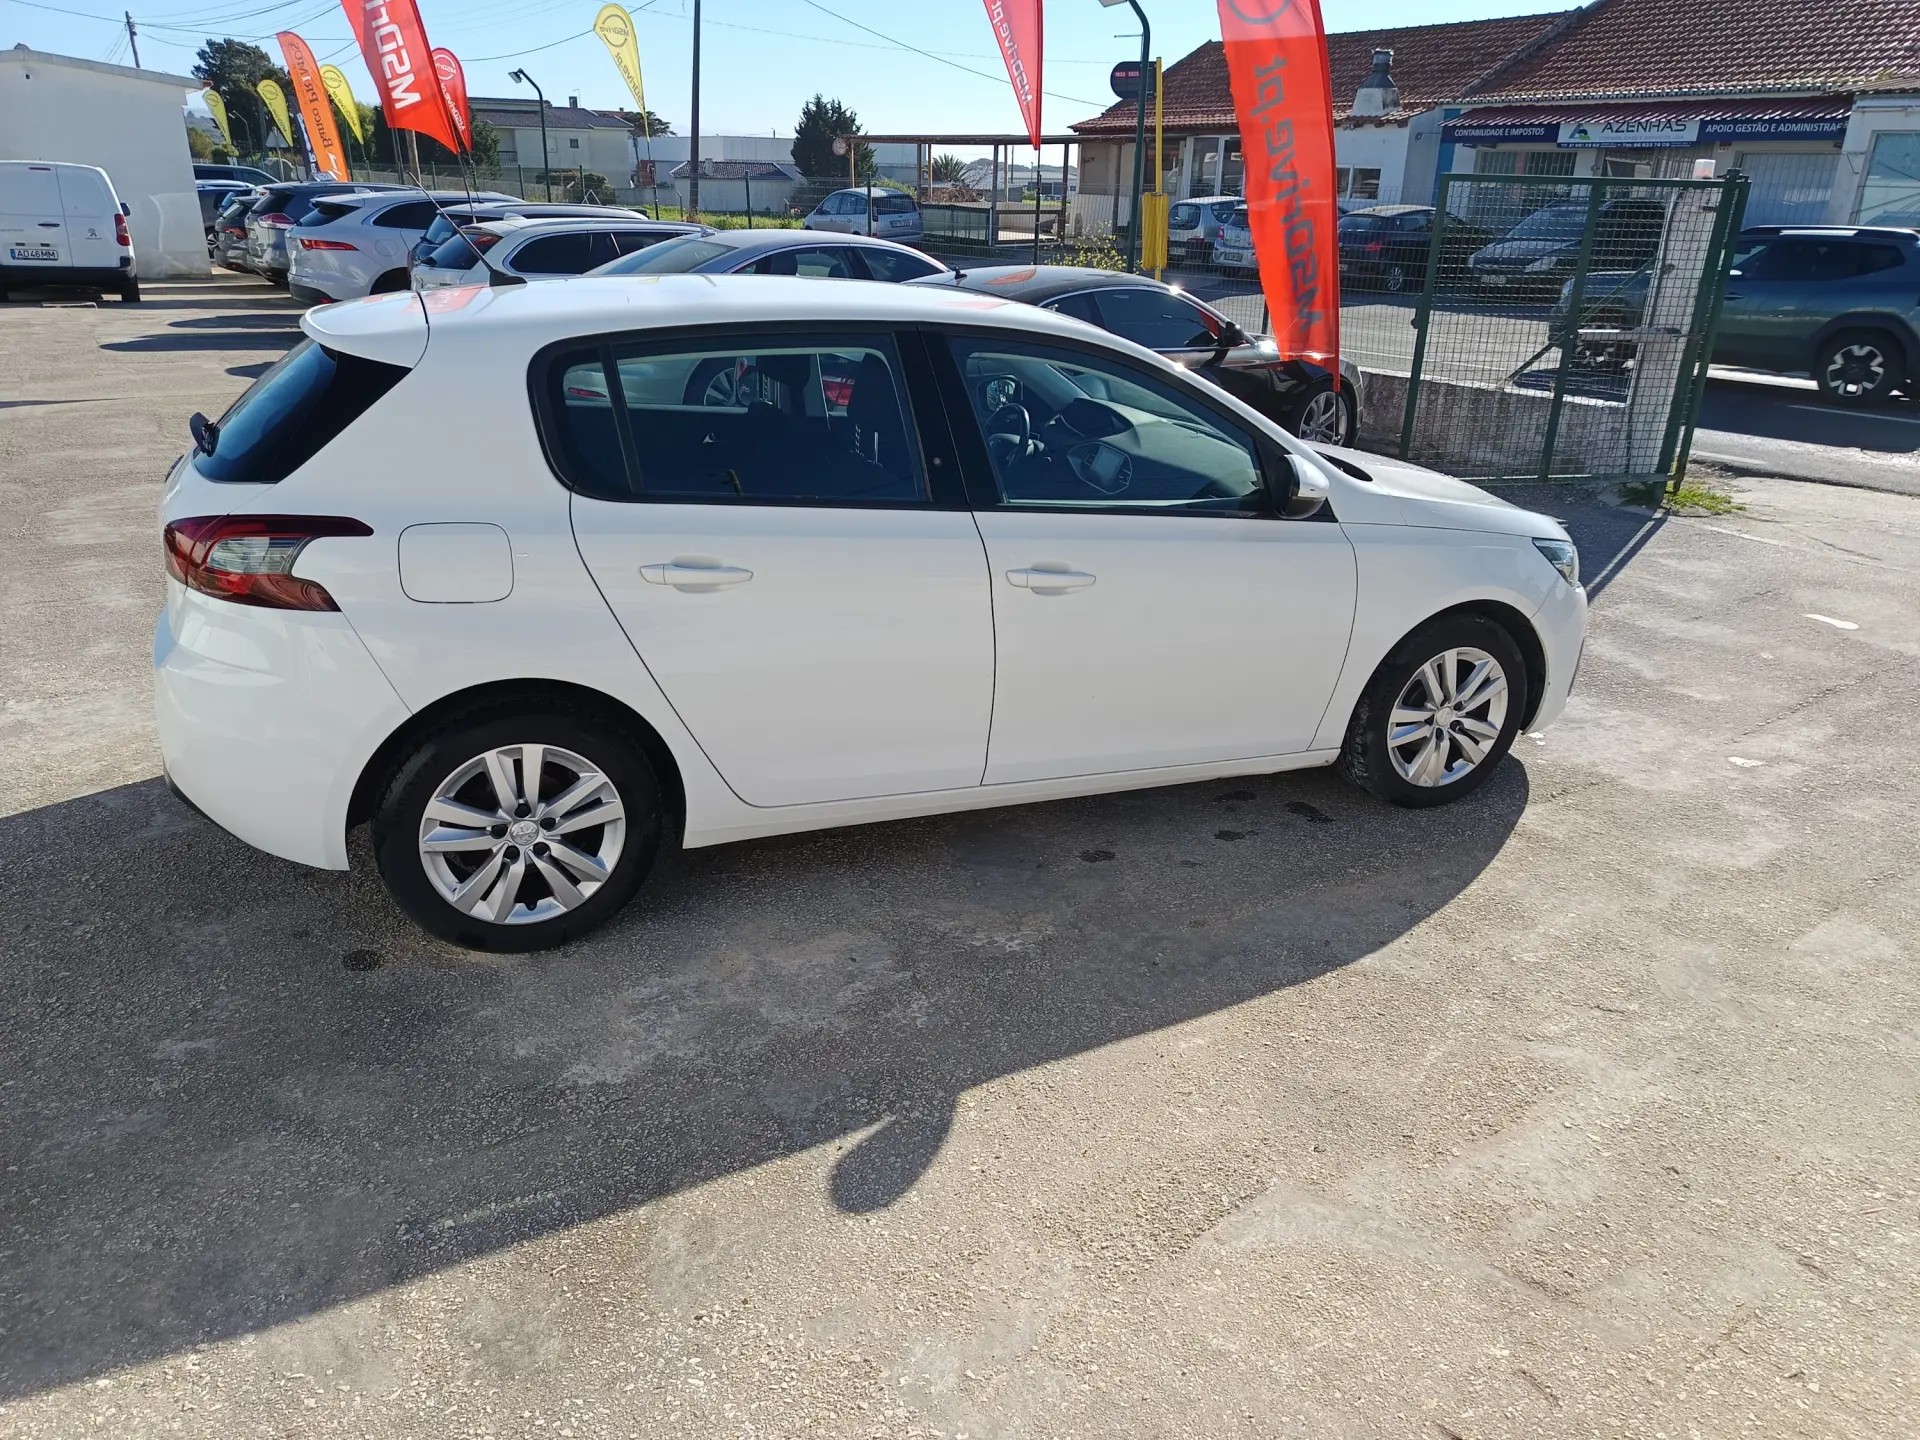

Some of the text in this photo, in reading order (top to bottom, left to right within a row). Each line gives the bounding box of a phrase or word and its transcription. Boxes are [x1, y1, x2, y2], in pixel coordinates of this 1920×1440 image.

[1601, 119, 1687, 133] AZENHAS
[1706, 123, 1733, 133] APOIO
[1735, 122, 1768, 132] GESTÃO
[1770, 123, 1776, 132] E
[1455, 127, 1545, 136] CONTABILIDADE E IMPOSTOS
[17, 249, 29, 258] AD
[40, 250, 56, 259] MM
